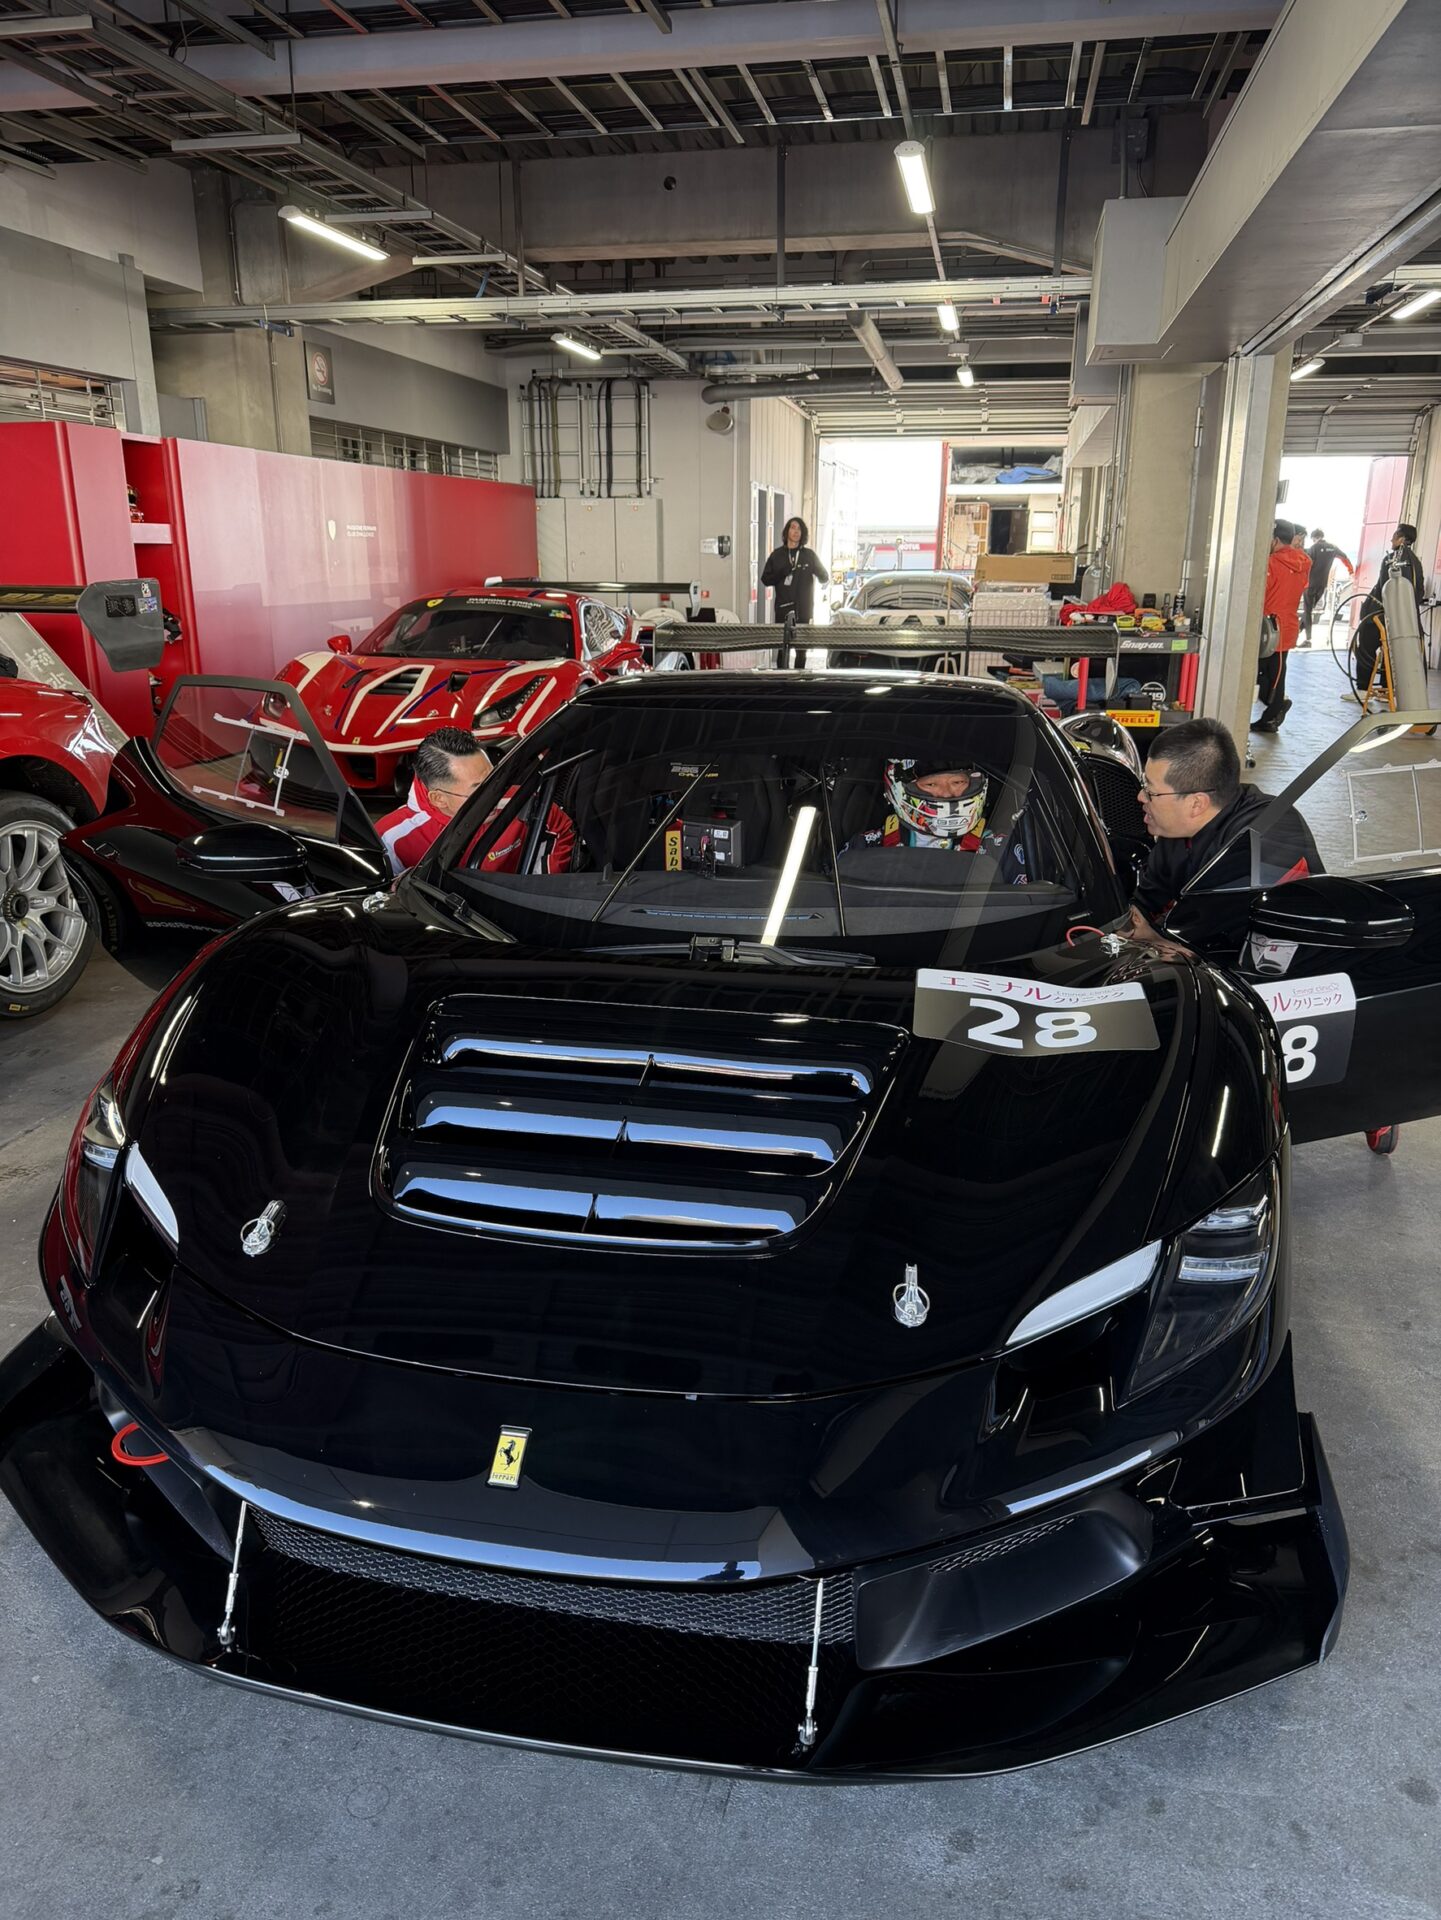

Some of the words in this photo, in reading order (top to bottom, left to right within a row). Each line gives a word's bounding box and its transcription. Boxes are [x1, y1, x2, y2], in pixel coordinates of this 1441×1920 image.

[1265, 992, 1342, 1013] ルクリニック
[968, 997, 1098, 1049] 28
[492, 1472, 516, 1481] Ferrari
